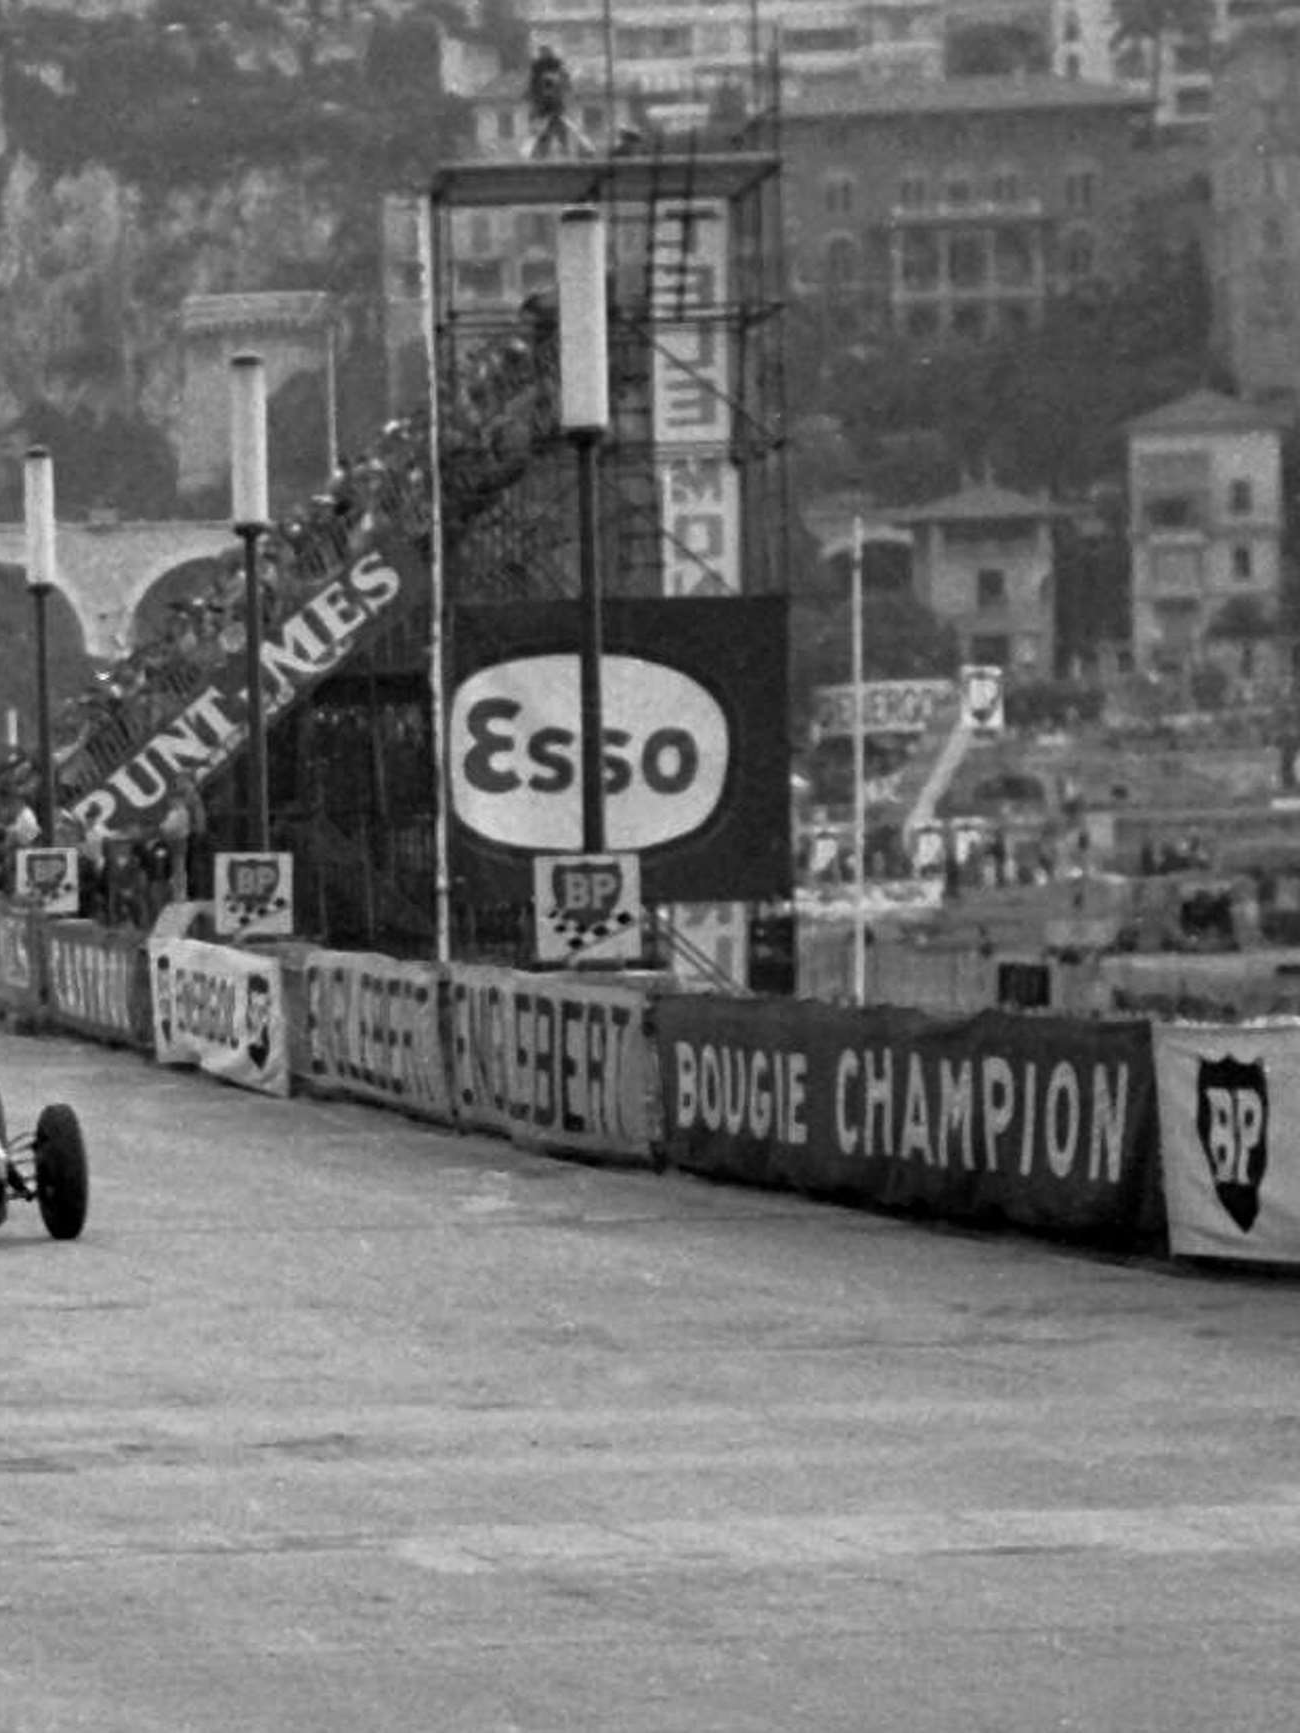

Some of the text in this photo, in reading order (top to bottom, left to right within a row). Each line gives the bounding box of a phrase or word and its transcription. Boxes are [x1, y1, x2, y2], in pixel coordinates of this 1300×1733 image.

[63, 552, 399, 838] PUNT MES
[464, 697, 698, 794] Esso
[235, 866, 277, 896] BP
[564, 872, 618, 909] BP
[675, 1041, 1129, 1184] BOUGIE CHAMPION
[1208, 1087, 1262, 1186] BP
